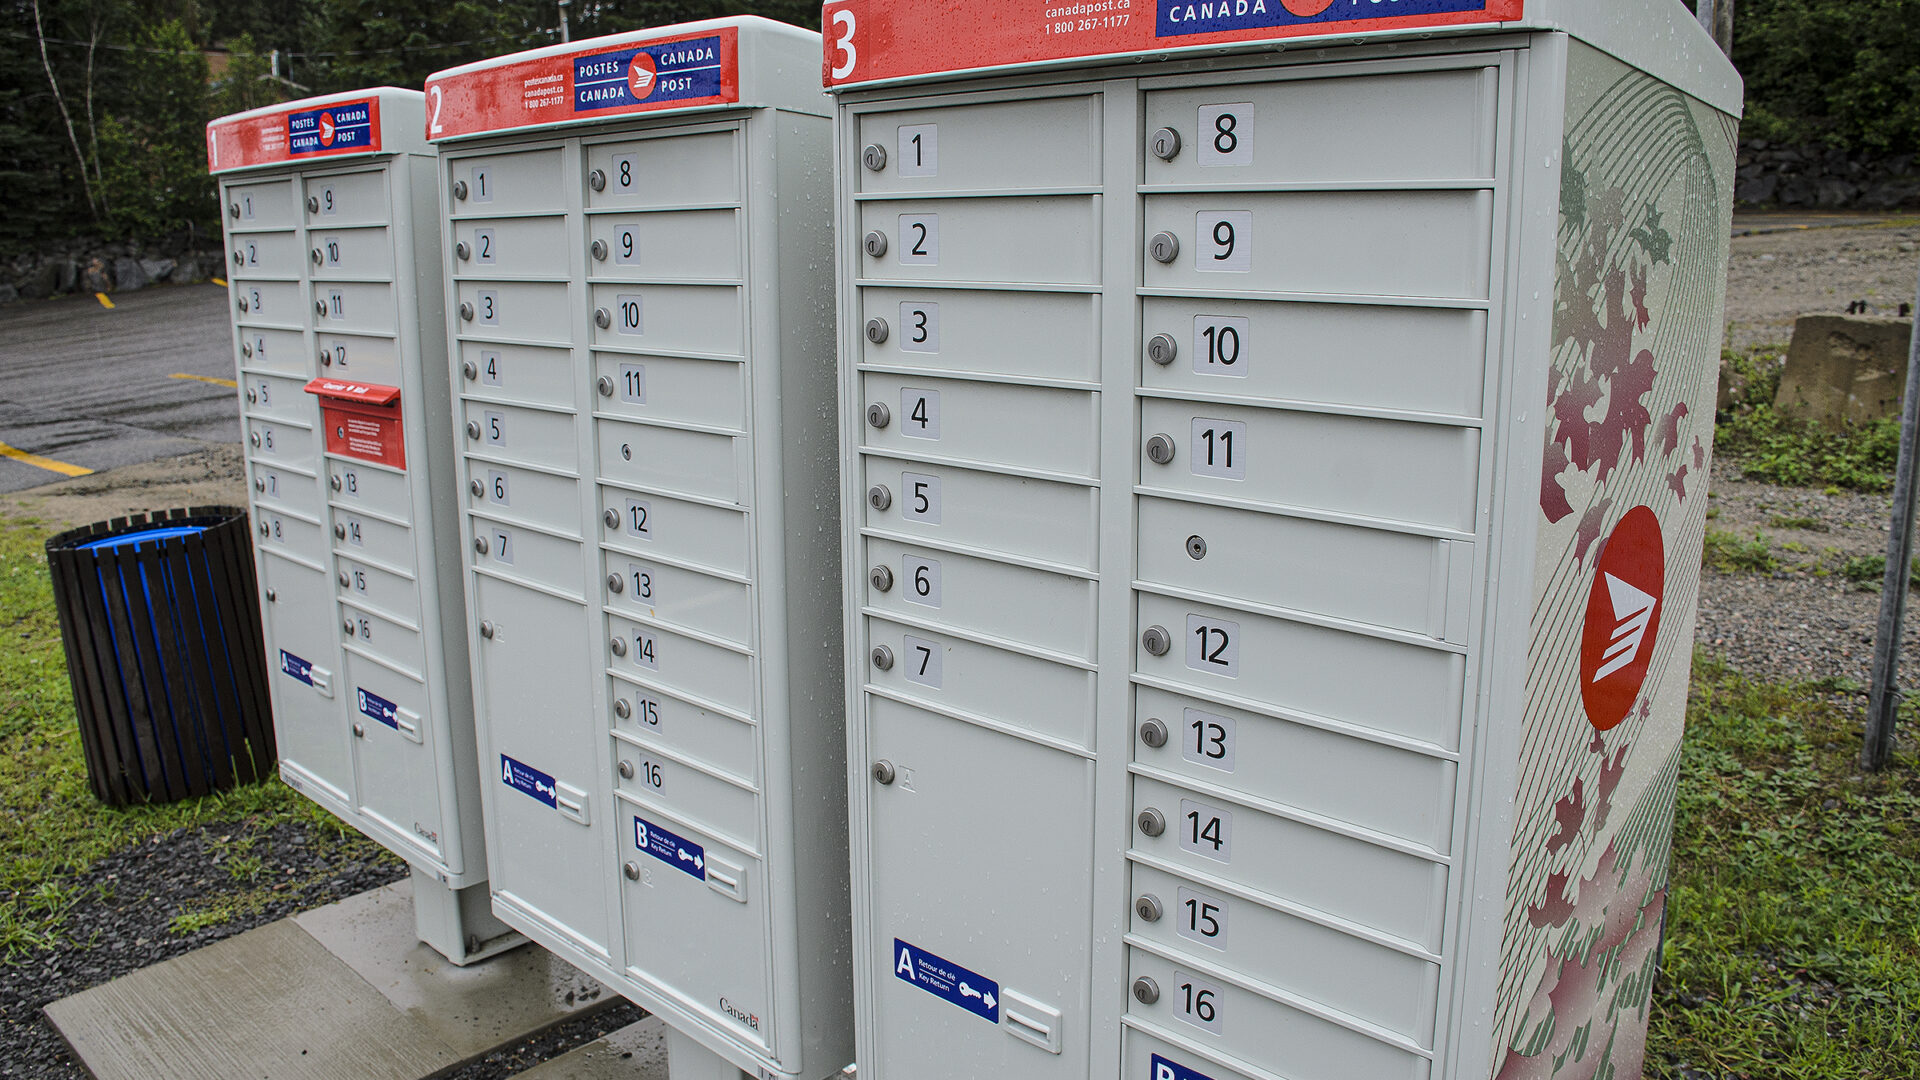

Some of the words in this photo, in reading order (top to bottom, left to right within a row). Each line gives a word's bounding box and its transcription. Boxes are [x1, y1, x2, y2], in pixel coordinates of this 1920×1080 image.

[1046, 0, 1130, 18] canadapost.ca
[1169, 0, 1267, 23] CANADA
[1045, 24, 1050, 35] 1
[1054, 21, 1074, 34] 800
[1078, 14, 1130, 31] 267-1177
[832, 9, 856, 79] 3
[580, 61, 619, 77] POSTES
[660, 48, 713, 66] CANADA
[524, 86, 564, 98] canadapost.ca
[540, 96, 564, 107] 267-1177
[580, 86, 625, 103] CANADA
[662, 77, 692, 92] POST
[292, 118, 314, 129] POSTES
[336, 110, 366, 122] CANADA
[430, 86, 442, 134] 2
[293, 136, 318, 148] CANADA
[338, 132, 355, 142] POST
[1215, 114, 1237, 153] 8
[210, 130, 218, 167] 1
[912, 134, 921, 166] 1
[480, 174, 484, 195] 1
[621, 161, 631, 186] 8
[247, 198, 250, 214] 1
[326, 190, 332, 209] 9
[482, 236, 490, 258] 2
[623, 232, 632, 258] 9
[912, 223, 927, 255] 2
[1213, 221, 1234, 260] 9
[250, 245, 256, 263] 2
[329, 243, 338, 262] 10
[254, 292, 259, 309] 3
[333, 296, 341, 313] 11
[485, 297, 493, 319] 3
[622, 302, 639, 328] 10
[913, 311, 927, 342] 3
[258, 339, 264, 355] 4
[336, 347, 346, 365] 12
[1203, 327, 1239, 365] 10
[488, 358, 496, 379] 4
[262, 386, 267, 402] 5
[626, 371, 640, 396] 11
[912, 398, 928, 428] 4
[267, 432, 272, 448] 6
[492, 418, 499, 439] 5
[1202, 429, 1232, 467] 11
[271, 476, 275, 491] 7
[347, 474, 356, 492] 13
[496, 477, 503, 499] 6
[915, 482, 928, 513] 5
[275, 521, 281, 537] 8
[631, 506, 647, 532] 12
[351, 523, 360, 541] 14
[499, 535, 506, 556] 7
[355, 572, 365, 590] 15
[634, 572, 651, 598] 13
[915, 566, 930, 596] 6
[360, 620, 369, 638] 16
[637, 637, 654, 662] 14
[1196, 626, 1228, 666] 12
[282, 652, 289, 672] A
[917, 646, 930, 675] 7
[360, 691, 367, 711] B
[641, 700, 658, 725] 15
[1192, 721, 1226, 759] 13
[503, 760, 514, 784] A
[644, 762, 661, 787] 16
[636, 821, 648, 848] B
[1188, 811, 1223, 850] 14
[1186, 899, 1219, 937] 15
[897, 948, 915, 980] A
[919, 959, 938, 972] Retour
[938, 969, 946, 977] de
[919, 972, 929, 983] Key
[930, 977, 950, 992] Return
[719, 997, 759, 1031] Canada
[1181, 984, 1215, 1021] 16
